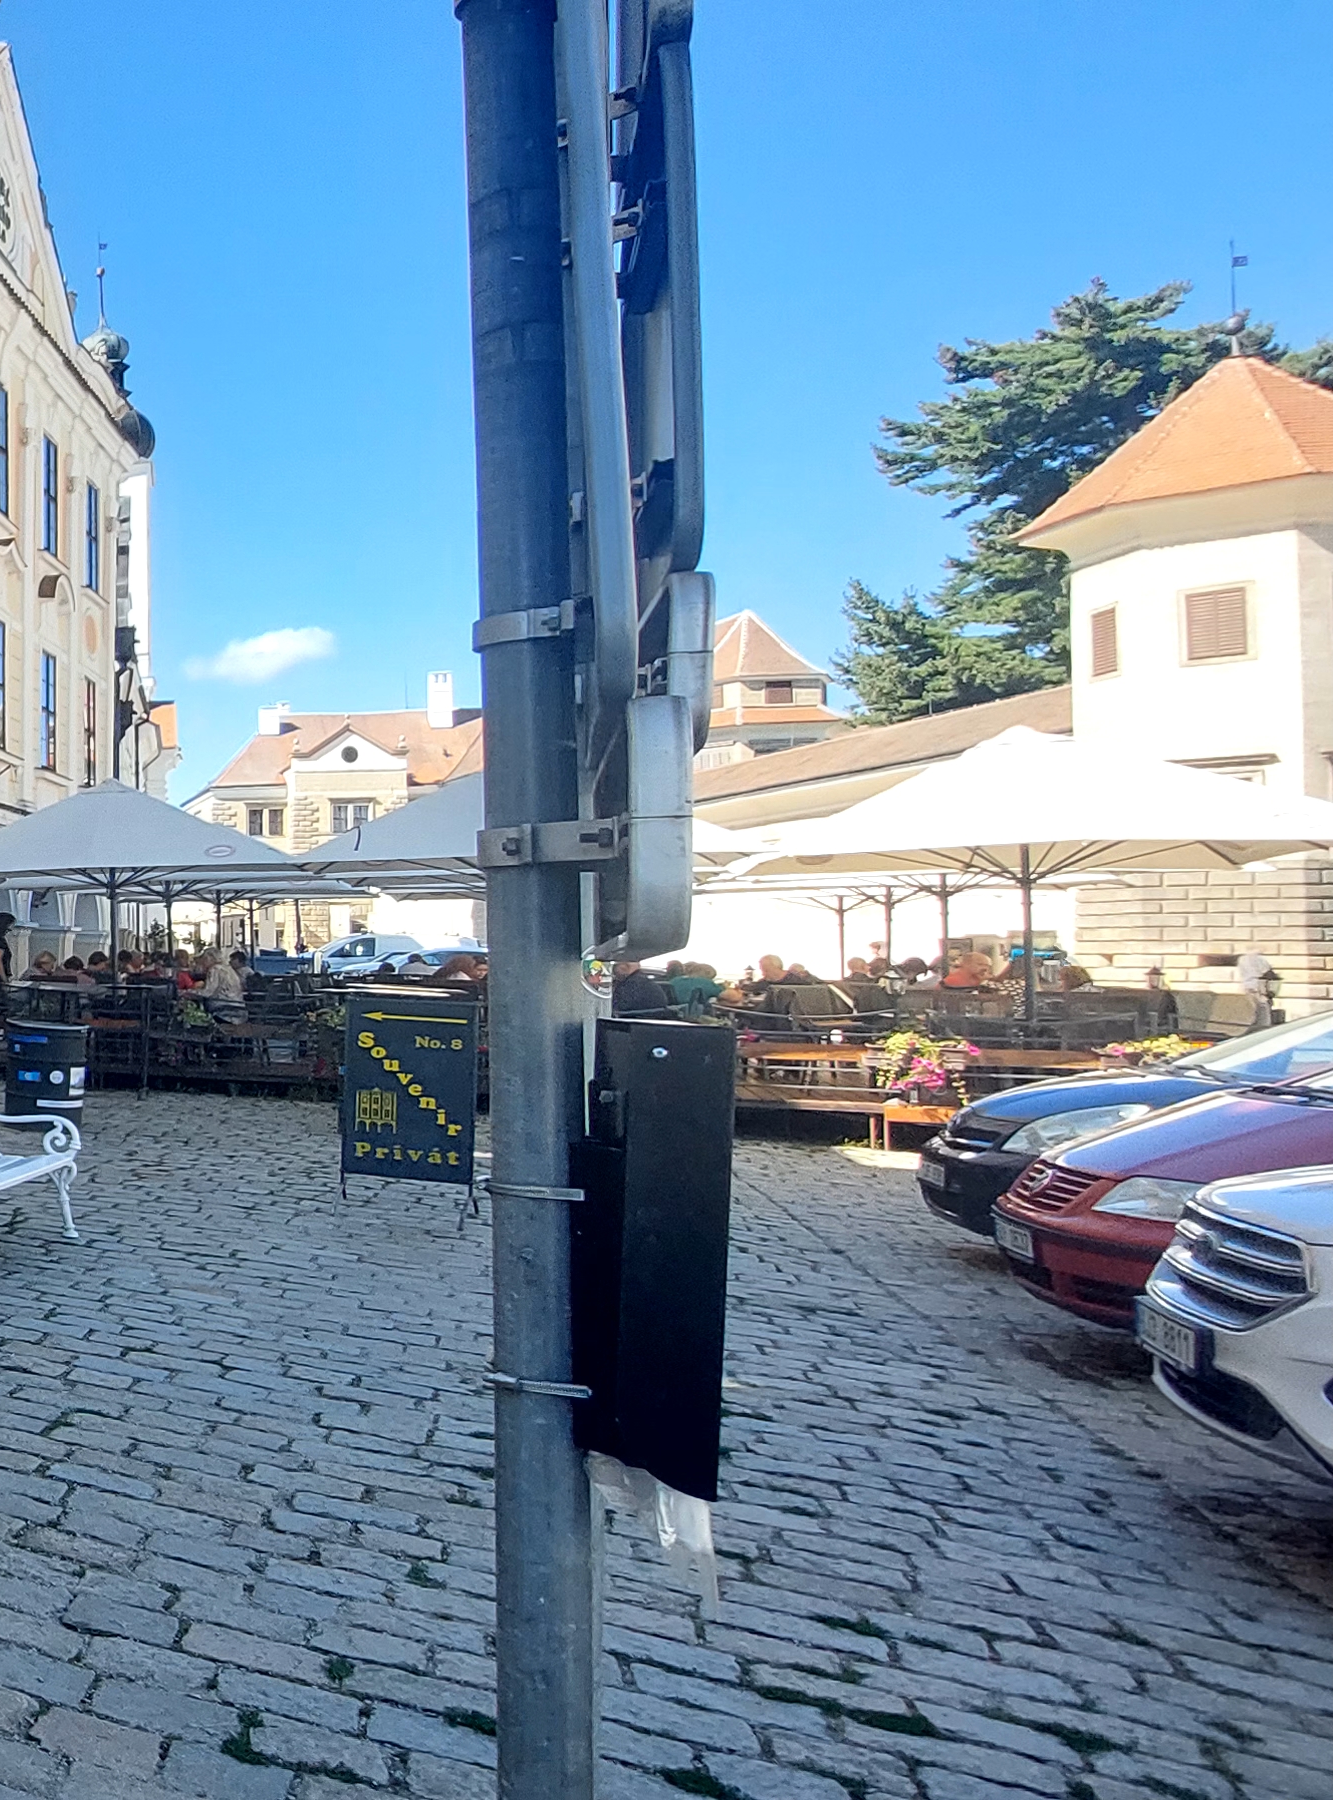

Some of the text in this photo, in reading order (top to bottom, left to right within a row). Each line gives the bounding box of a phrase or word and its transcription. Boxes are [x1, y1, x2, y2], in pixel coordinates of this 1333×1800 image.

[414, 1036, 463, 1050] No. 8
[357, 1031, 462, 1136] Souvenir
[354, 1141, 460, 1166] Privát
